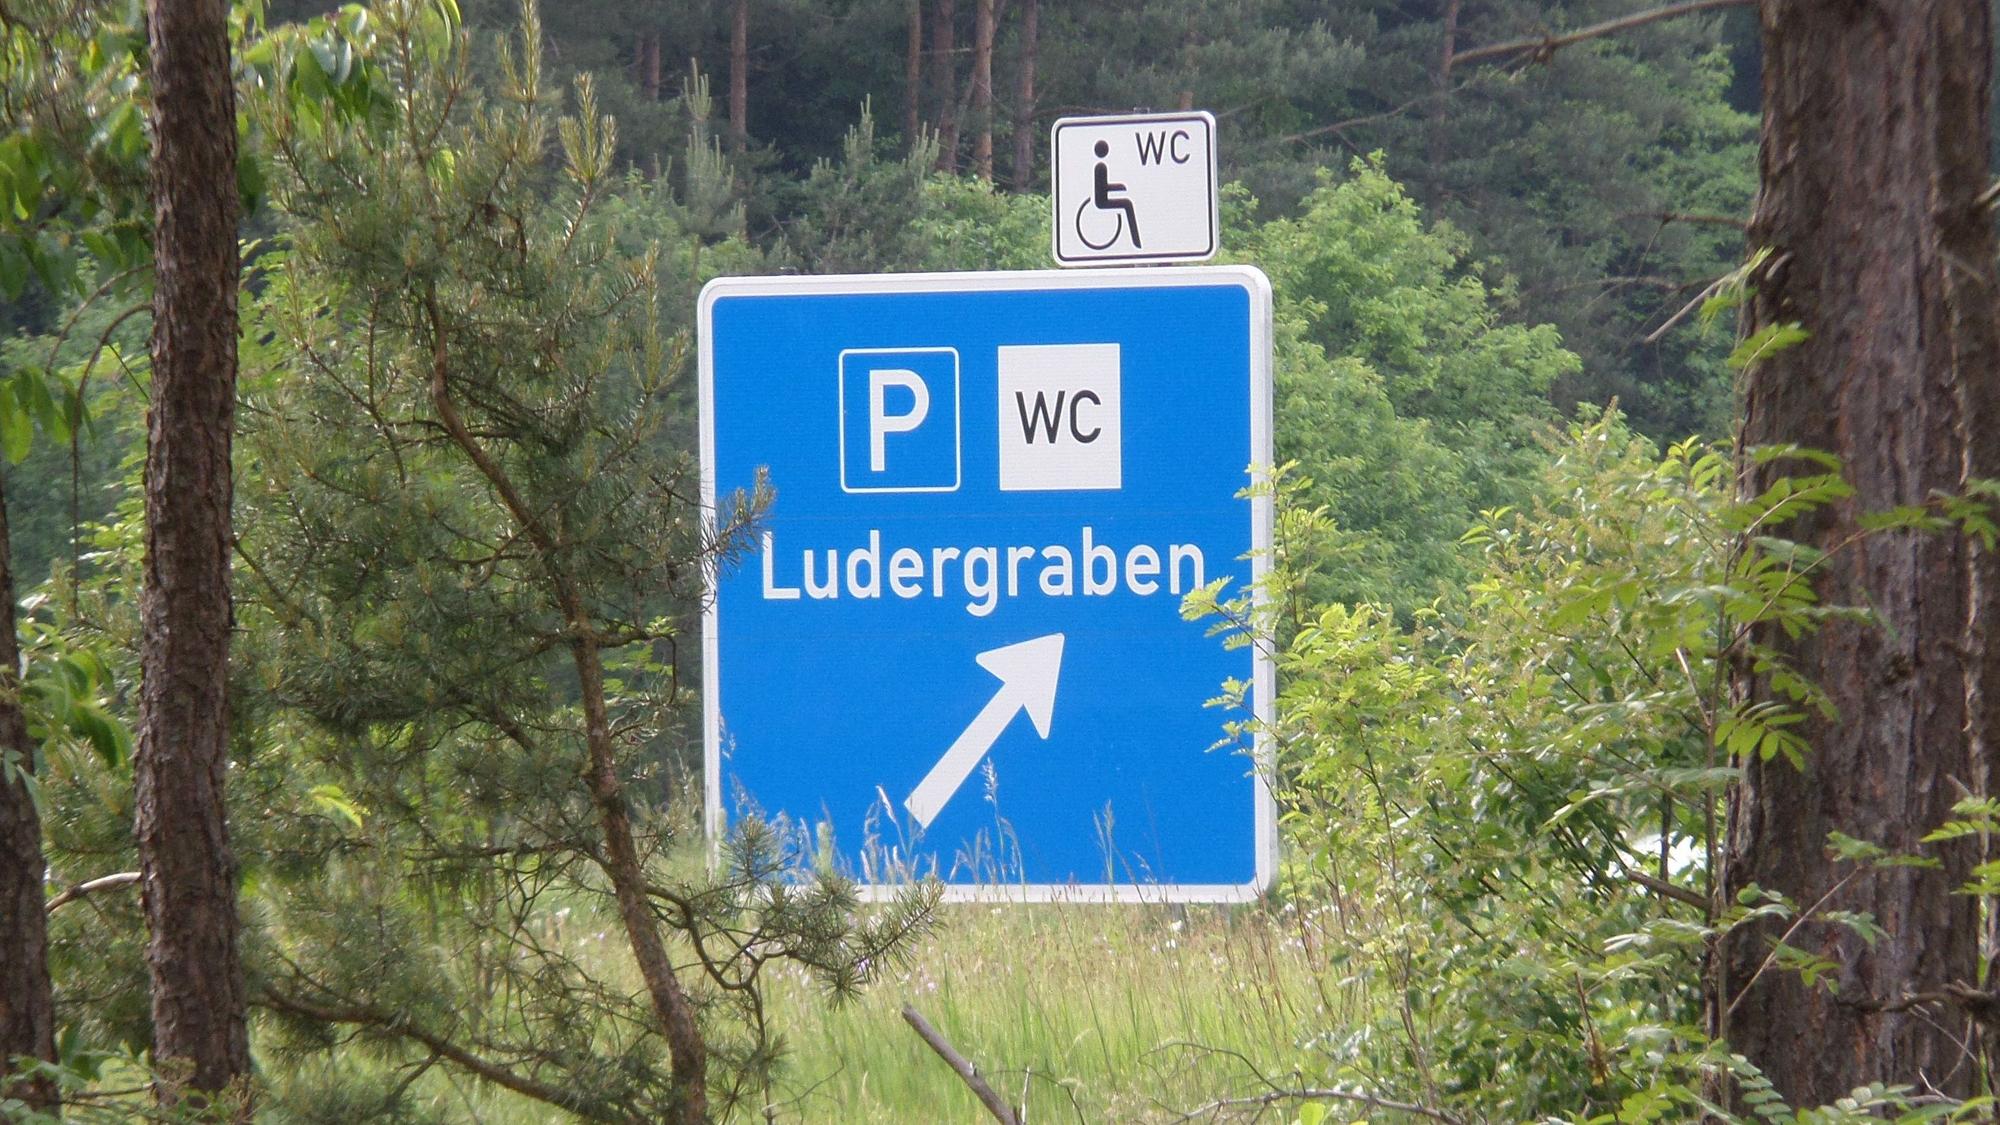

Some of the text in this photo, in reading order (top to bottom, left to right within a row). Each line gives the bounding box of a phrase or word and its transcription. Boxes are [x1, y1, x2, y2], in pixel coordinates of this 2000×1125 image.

[1135, 129, 1190, 166] WC
[868, 369, 1101, 472] P WC
[762, 526, 1204, 617] Ludergraben
